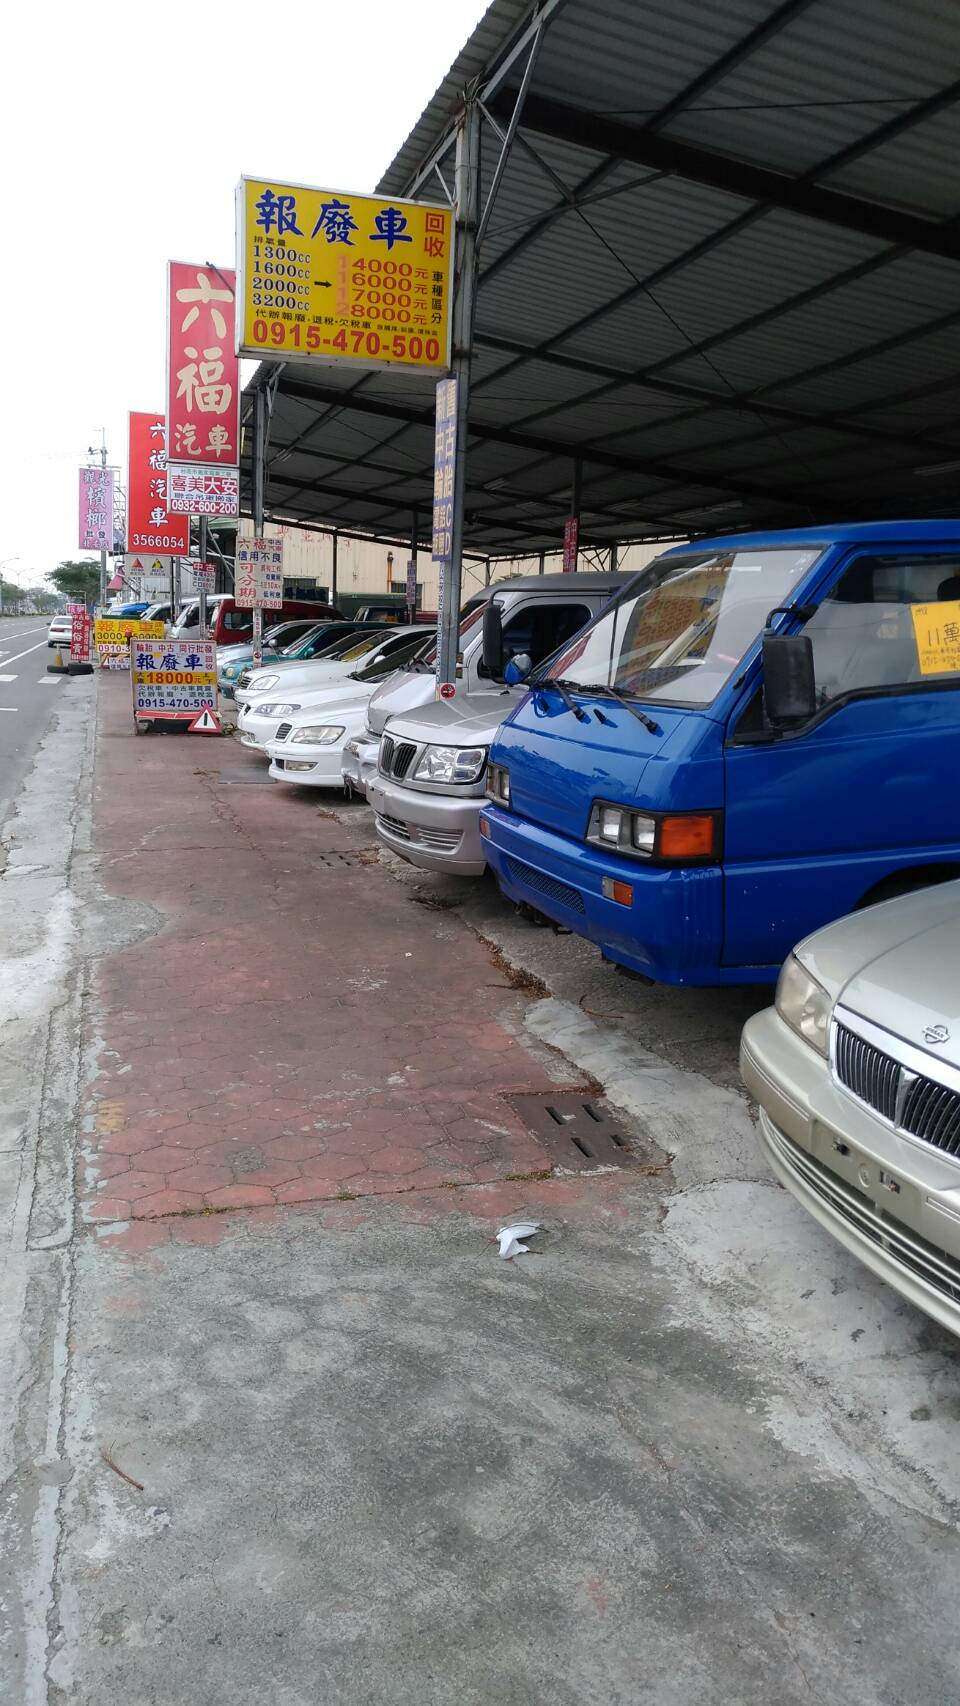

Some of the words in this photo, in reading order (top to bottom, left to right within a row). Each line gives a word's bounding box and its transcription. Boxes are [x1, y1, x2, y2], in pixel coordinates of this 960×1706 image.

[256, 190, 413, 250] 報廢車
[424, 212, 445, 258] 回收
[431, 271, 444, 324] 車種區分
[176, 272, 234, 414] 六福
[253, 319, 440, 361] 0915-470-500
[174, 423, 232, 458] 汽車
[436, 427, 455, 462] 中古
[149, 422, 168, 528] 六福汽車
[172, 475, 238, 496] 喜美大安
[172, 500, 236, 514] 0932-600-200
[133, 534, 184, 548] 3566054
[238, 550, 281, 563] 信用不良
[238, 562, 257, 598] 可分期
[236, 598, 282, 608] 0915-470-500
[136, 653, 202, 671] 報廢車
[159, 644, 174, 652] 中古
[147, 672, 201, 684] 18000元
[138, 699, 213, 708] 0915-470-500
